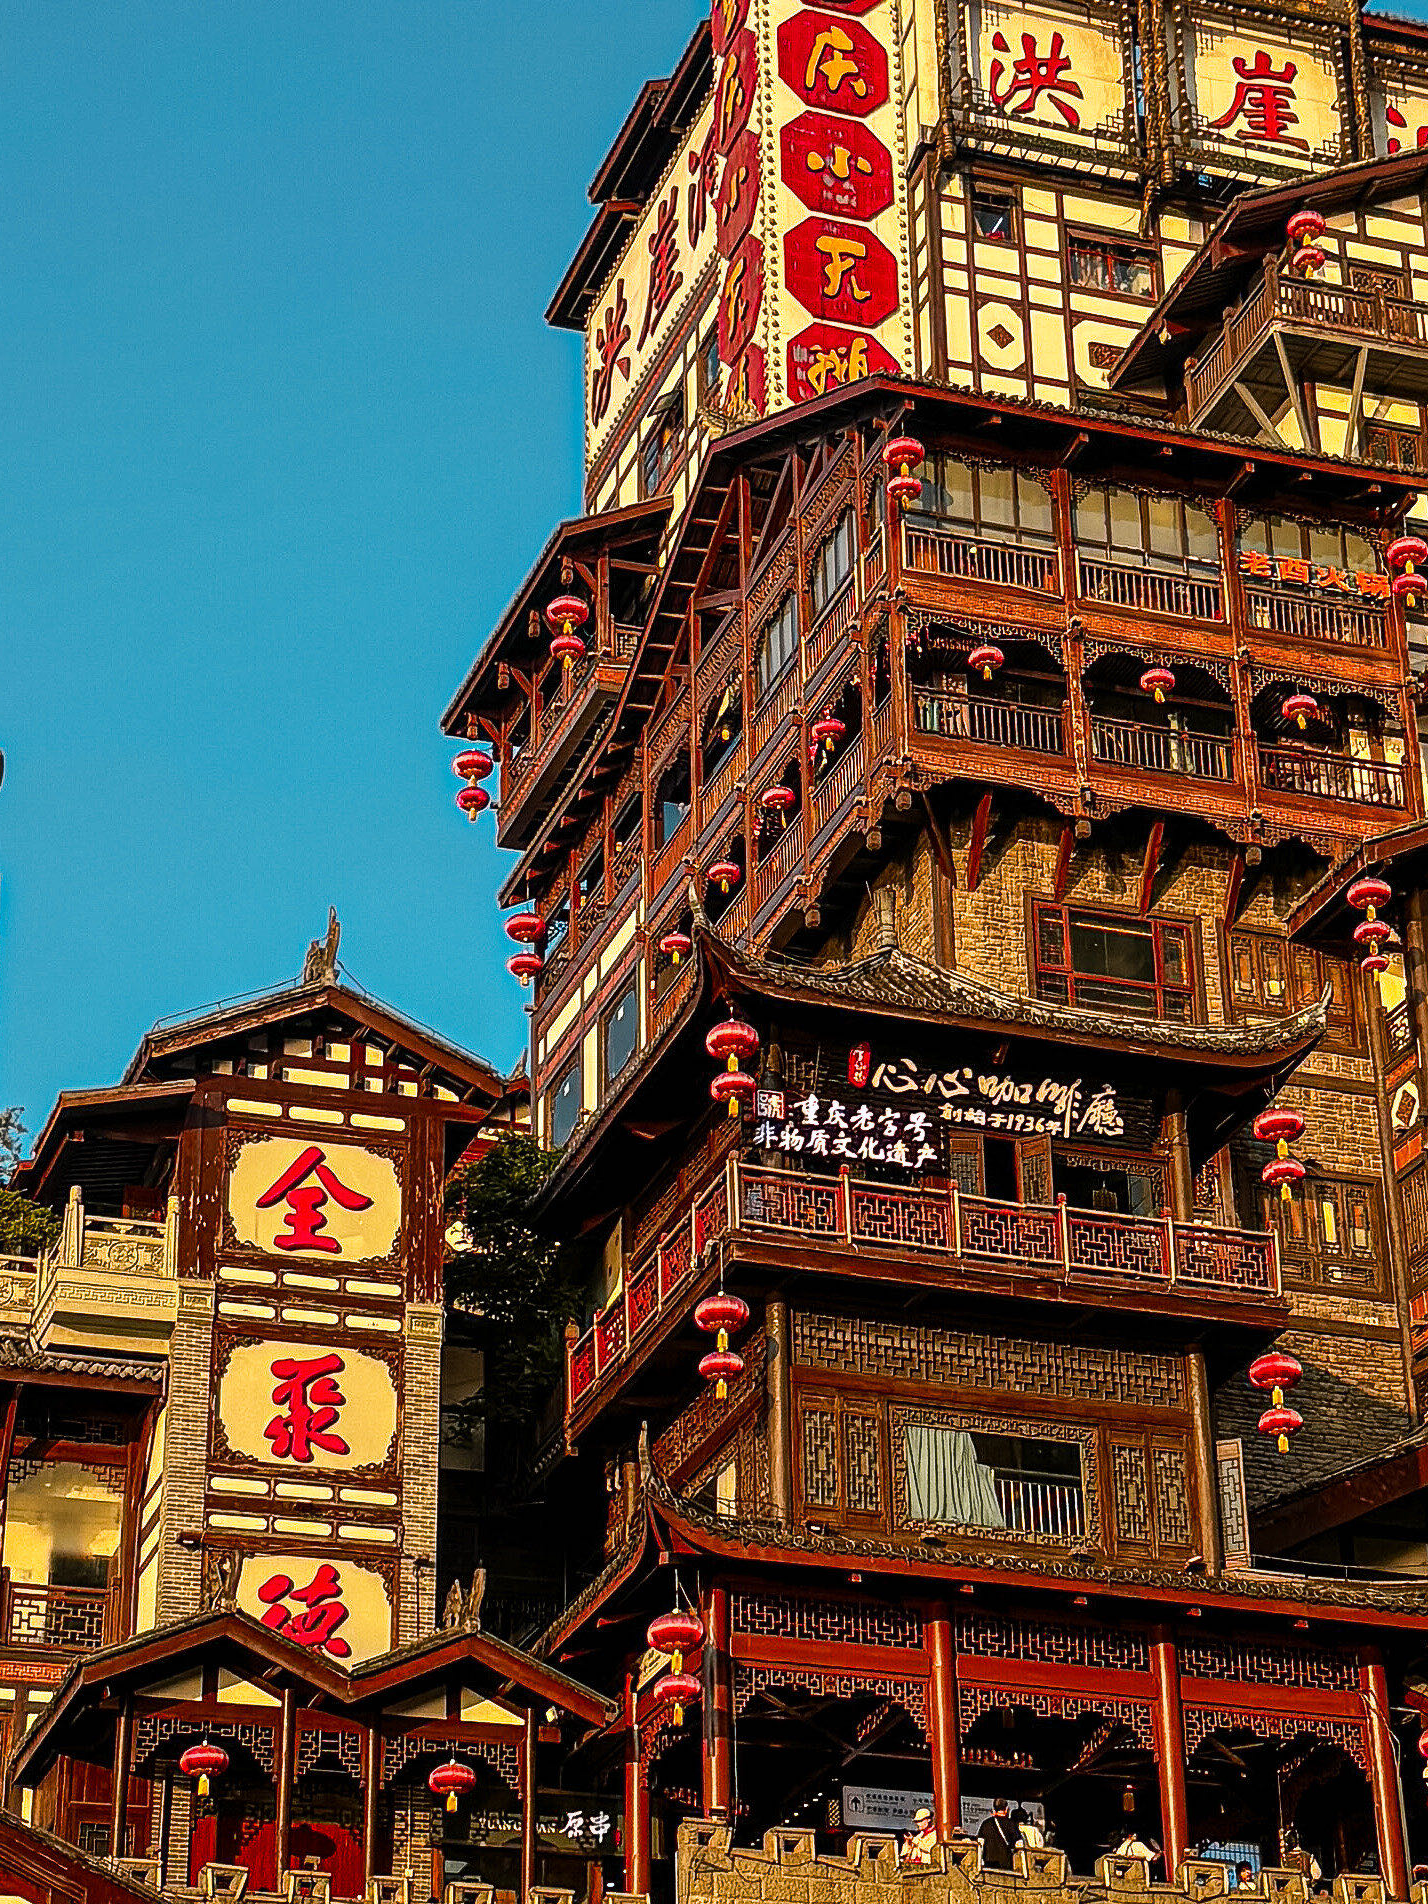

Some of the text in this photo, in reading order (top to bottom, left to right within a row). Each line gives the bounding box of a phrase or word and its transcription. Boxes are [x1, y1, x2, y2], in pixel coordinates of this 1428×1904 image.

[793, 1093, 933, 1142] 重庆老字号
[752, 1120, 938, 1169] 非物质文化遗产
